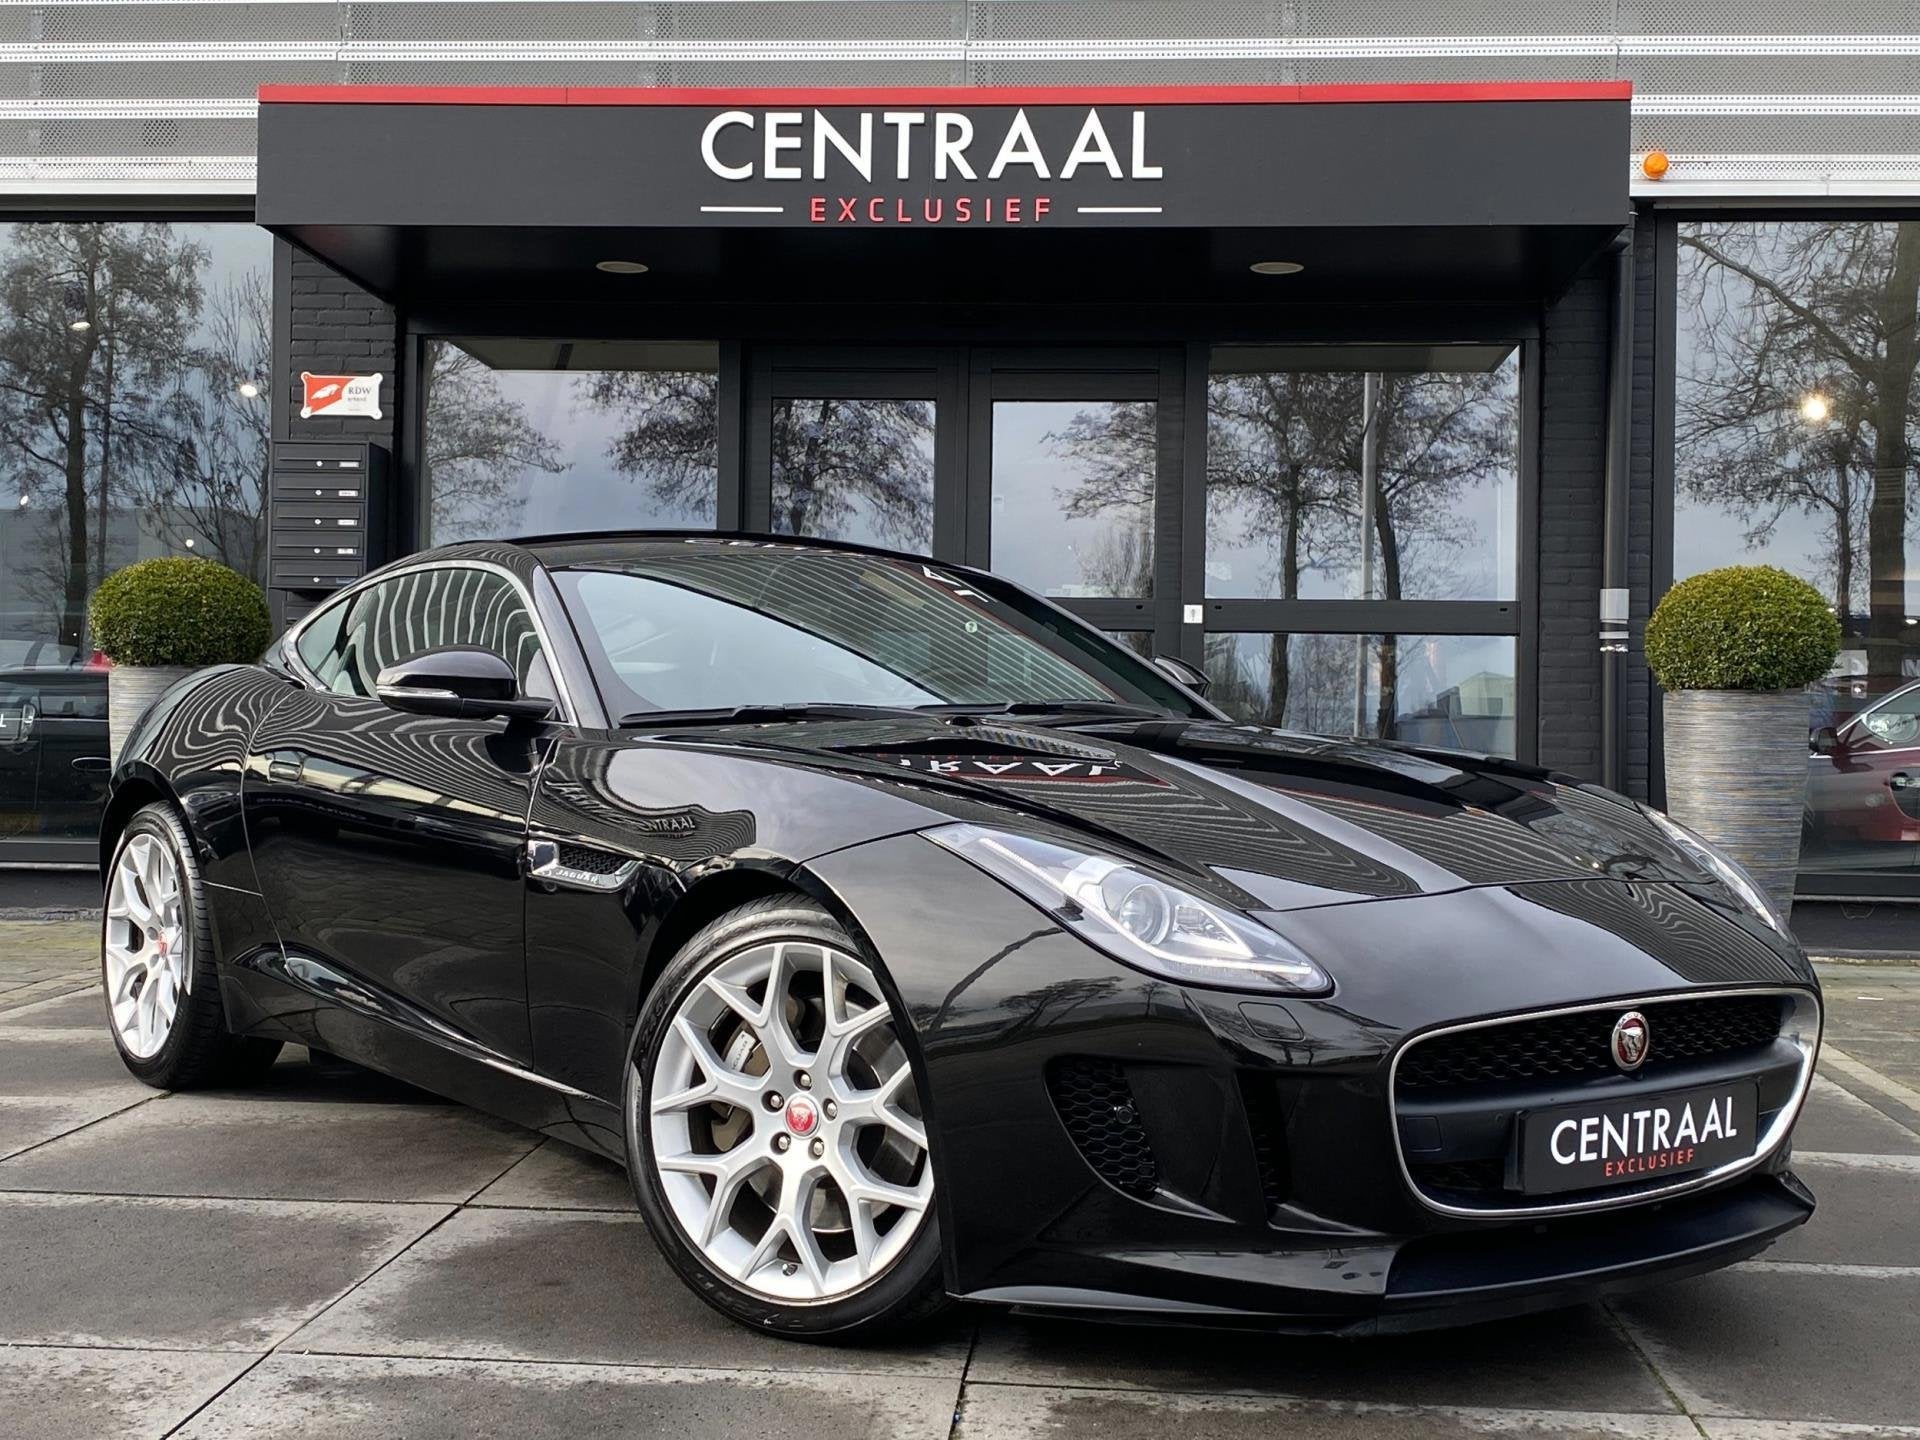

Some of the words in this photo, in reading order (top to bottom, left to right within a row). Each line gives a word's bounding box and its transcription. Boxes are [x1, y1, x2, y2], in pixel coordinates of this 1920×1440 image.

[701, 108, 1162, 182] CENTRAAL
[810, 197, 1048, 222] EXCLUSIEF
[348, 386, 371, 395] RDW
[555, 869, 600, 885] JAGUAR
[1551, 1096, 1737, 1164] CENTRAAL
[1605, 1149, 1694, 1177] EXCLUSIEF
